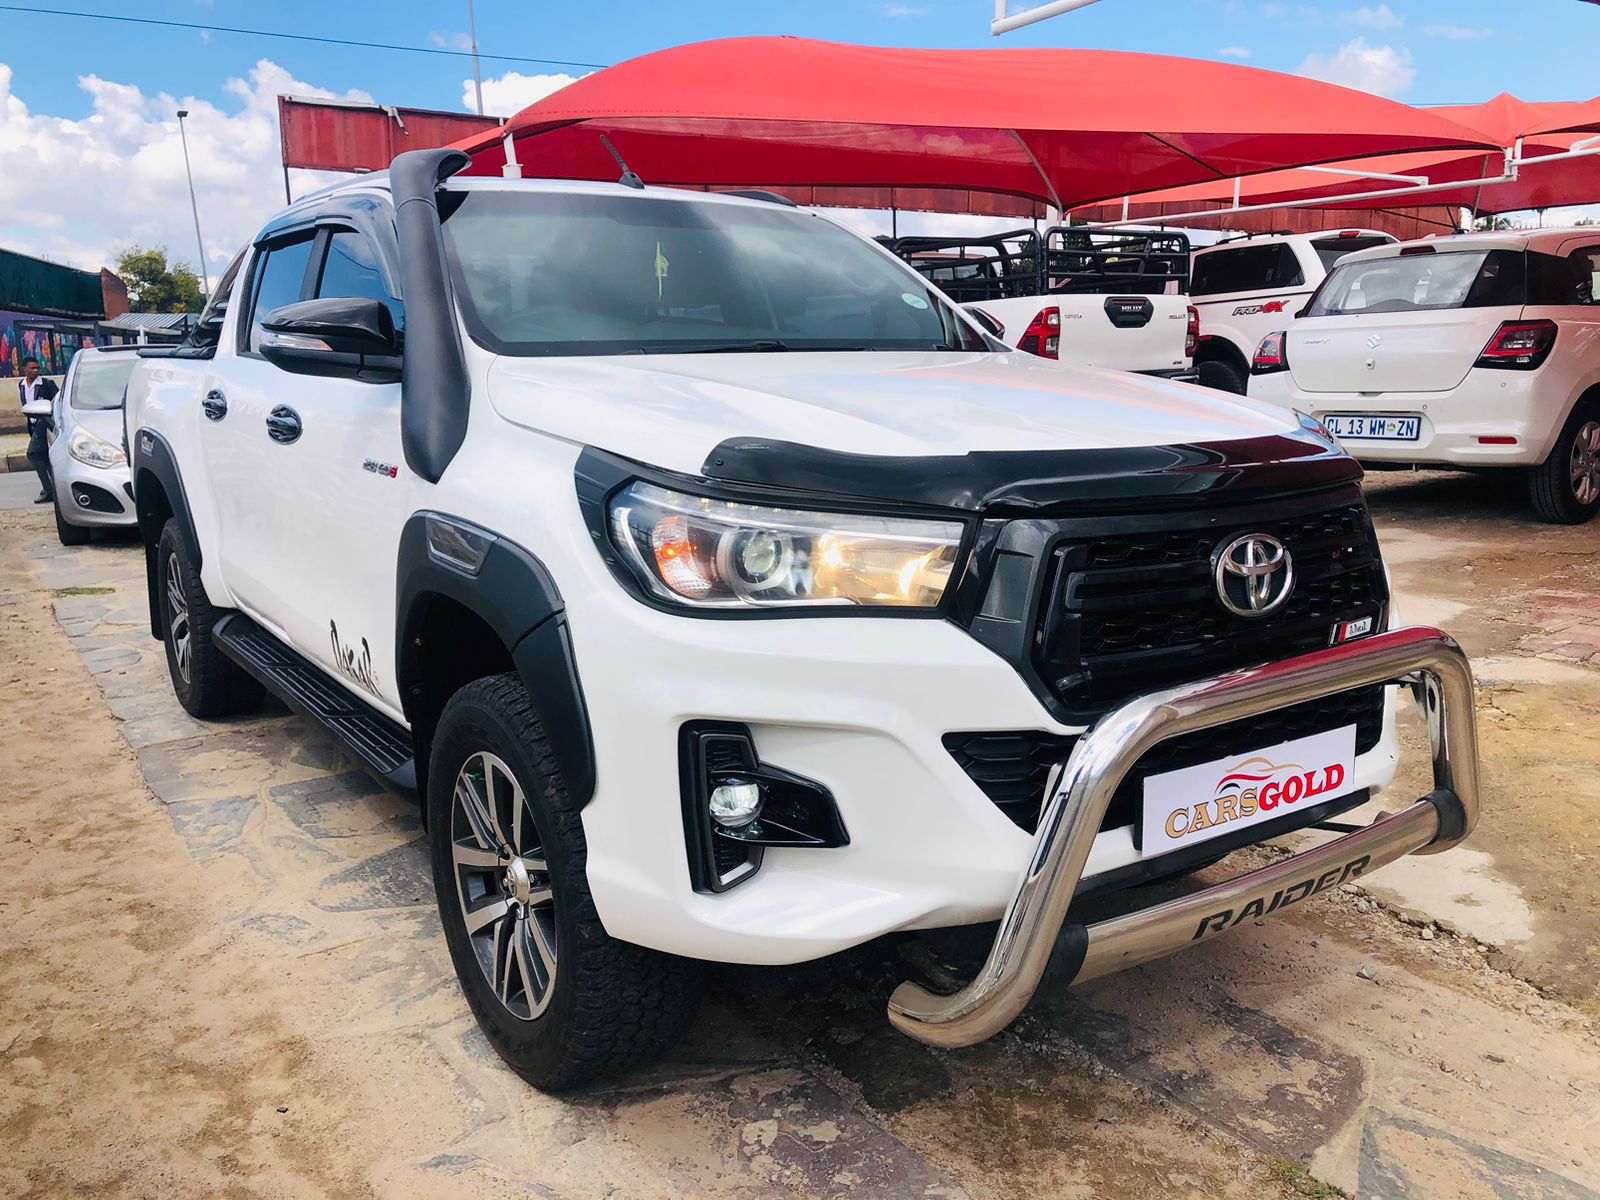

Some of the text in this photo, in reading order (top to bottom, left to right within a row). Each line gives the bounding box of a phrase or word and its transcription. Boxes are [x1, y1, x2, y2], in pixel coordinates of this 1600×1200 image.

[1327, 418, 1415, 437] CL 13 WM ZN
[1165, 763, 1345, 839] CARSGOLD
[1192, 854, 1371, 941] RAIDER
